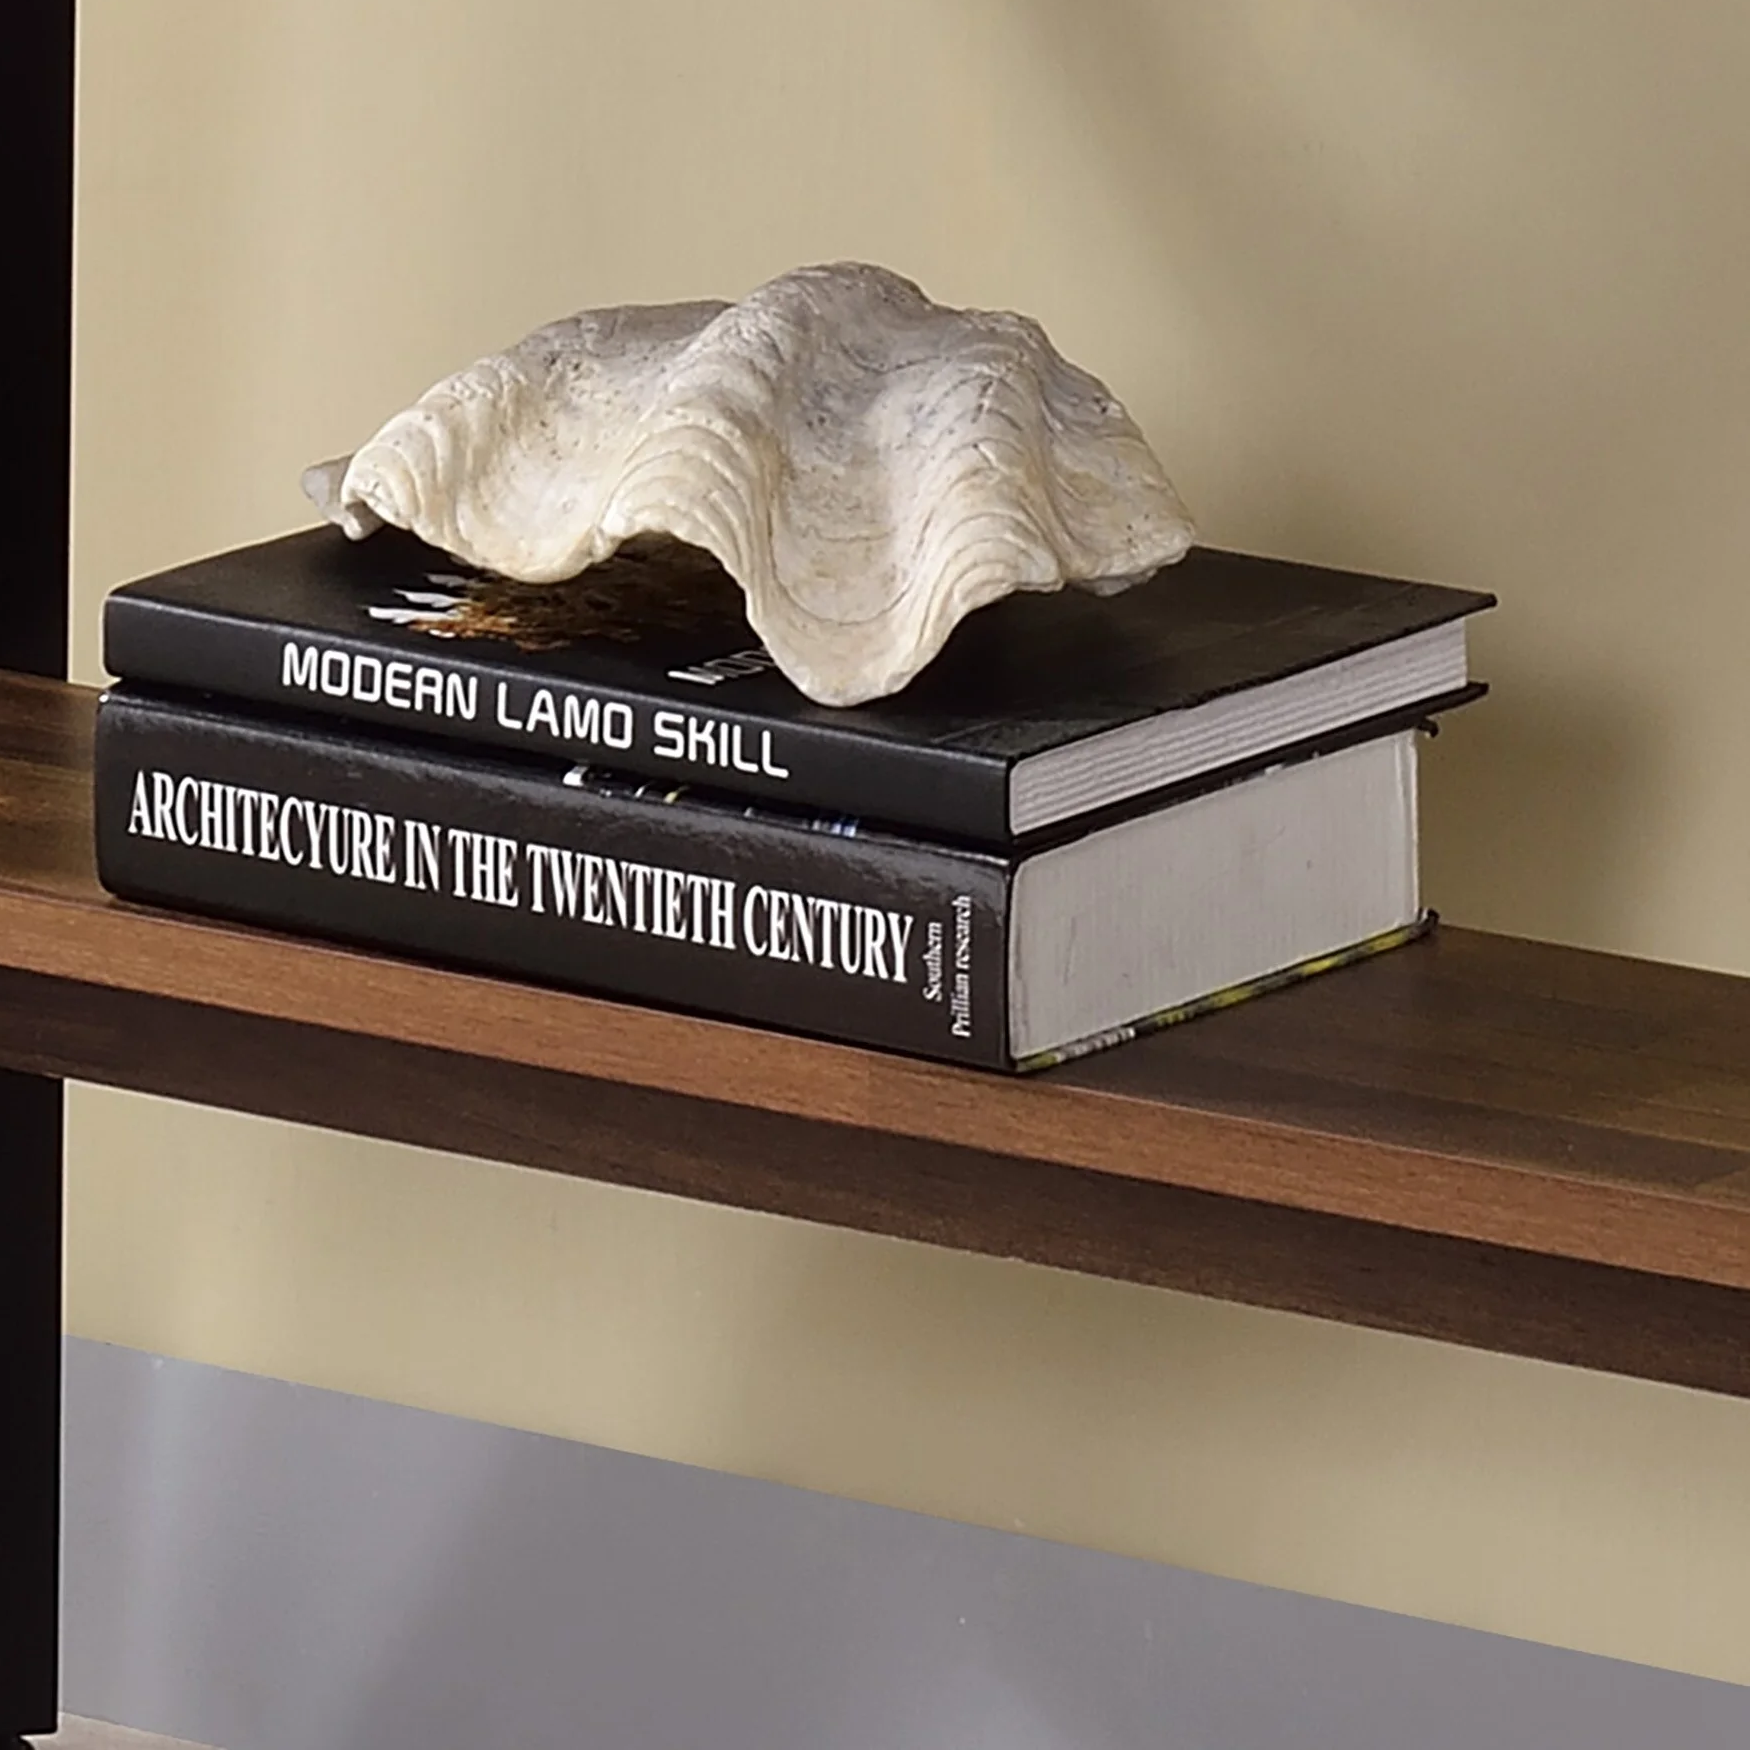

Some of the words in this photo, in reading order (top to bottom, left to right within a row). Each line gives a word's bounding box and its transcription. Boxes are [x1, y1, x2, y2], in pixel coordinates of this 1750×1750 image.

[282, 642, 478, 720] MODERN
[496, 681, 634, 749] LAMO
[653, 710, 789, 779] SKILL
[127, 768, 397, 886] ARCHITECYURE
[404, 819, 442, 893] IN
[449, 828, 519, 909] THE
[525, 842, 737, 950] TWENTIETH
[743, 884, 914, 984] CENTURY
[922, 920, 944, 1003] Southern
[951, 895, 973, 970] research
